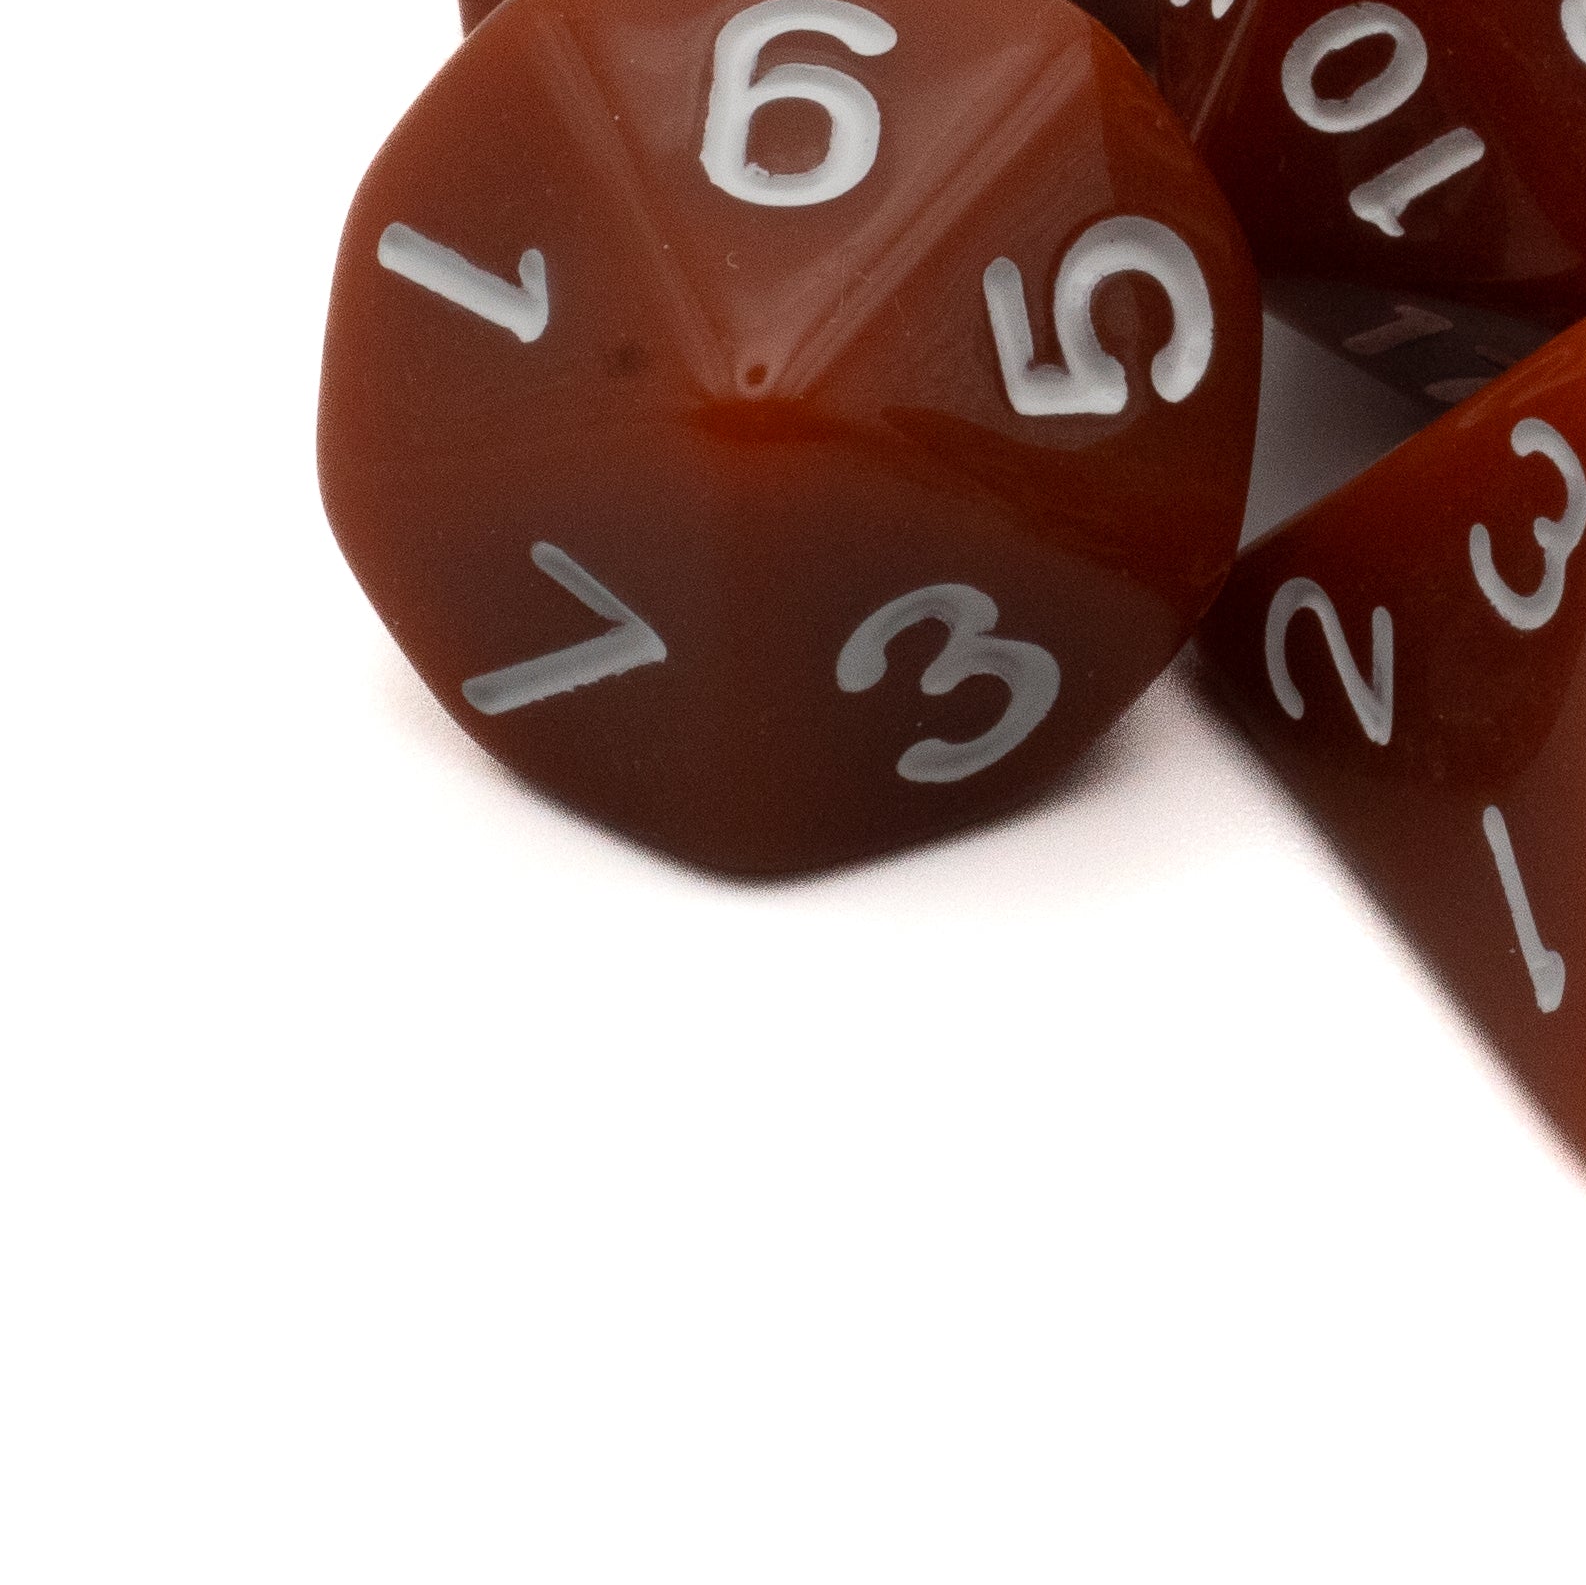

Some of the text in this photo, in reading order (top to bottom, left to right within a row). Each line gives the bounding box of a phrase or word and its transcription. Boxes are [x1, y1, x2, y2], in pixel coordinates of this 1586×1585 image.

[1281, 1, 1486, 237] 10
[377, 221, 550, 343] 1
[982, 215, 1214, 416] 5
[462, 541, 667, 716] 7
[836, 583, 1061, 783] 3
[1264, 577, 1394, 746] 2
[1482, 805, 1566, 1014] 1
